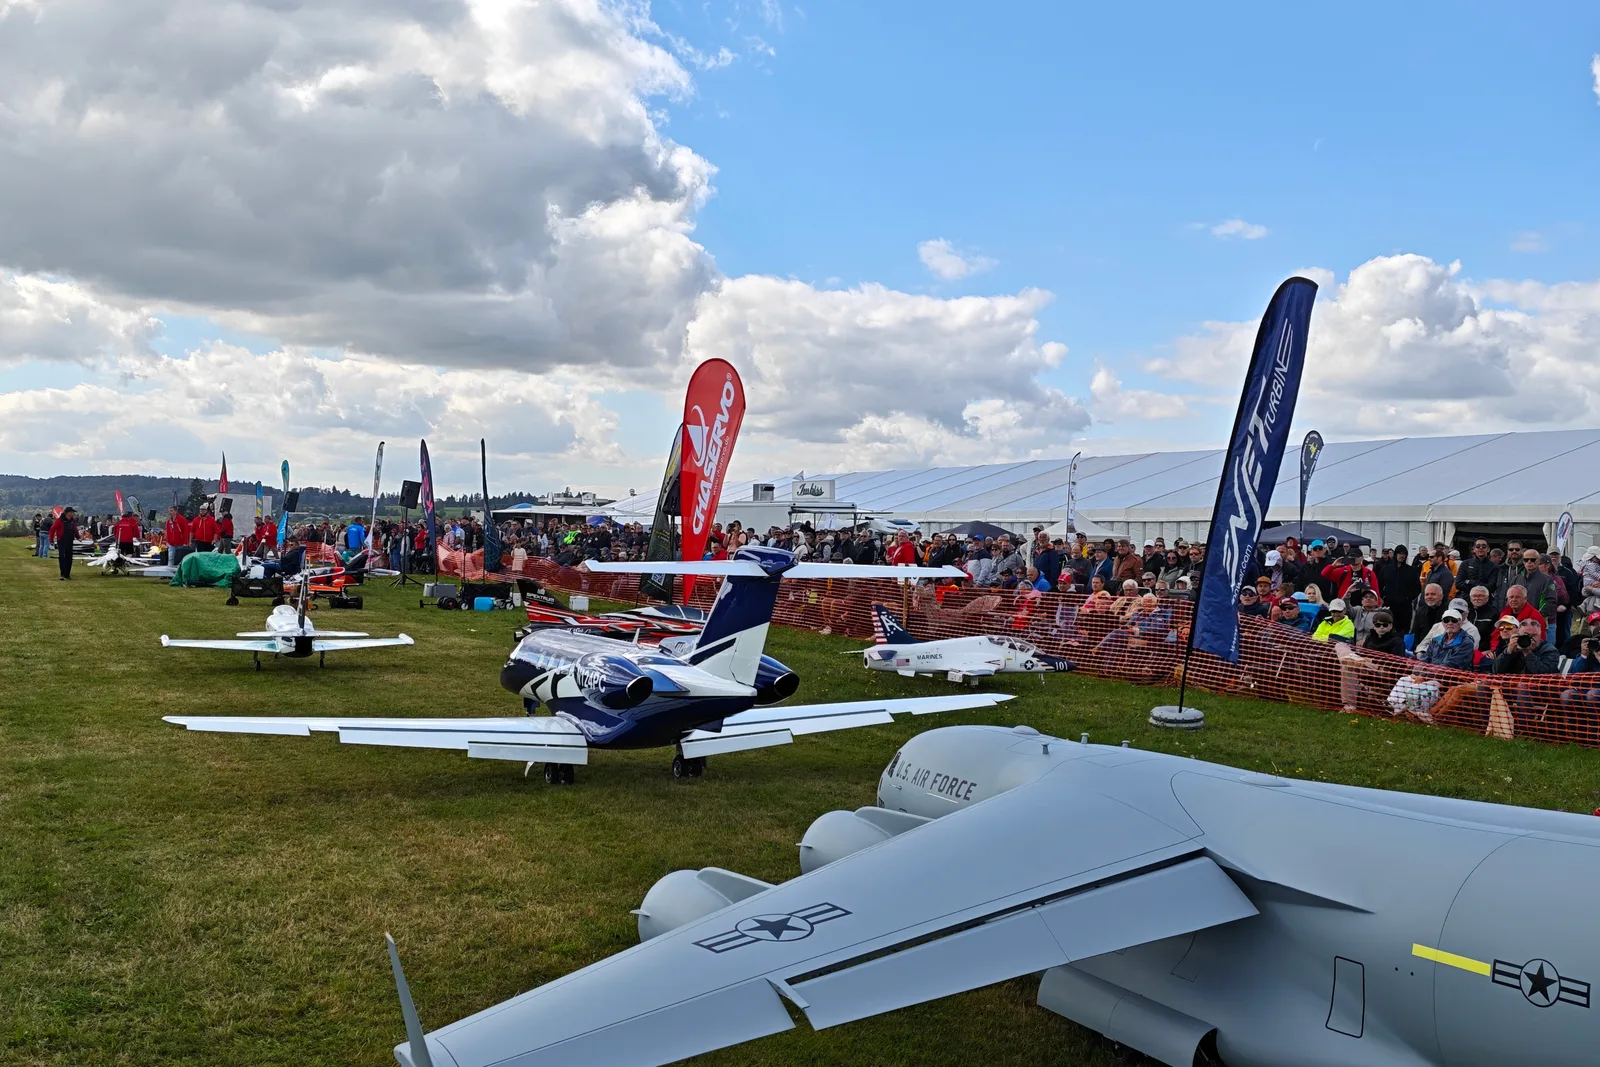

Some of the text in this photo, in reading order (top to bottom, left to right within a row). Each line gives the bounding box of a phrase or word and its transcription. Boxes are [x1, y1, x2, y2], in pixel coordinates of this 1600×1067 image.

[1262, 318, 1294, 434] TURBINE
[692, 380, 734, 534] CHASERVO
[797, 483, 825, 497] Imbiss
[916, 653, 943, 661] MARINES
[1055, 661, 1069, 671] 101
[896, 760, 977, 801] U.S. AIR FORCE
